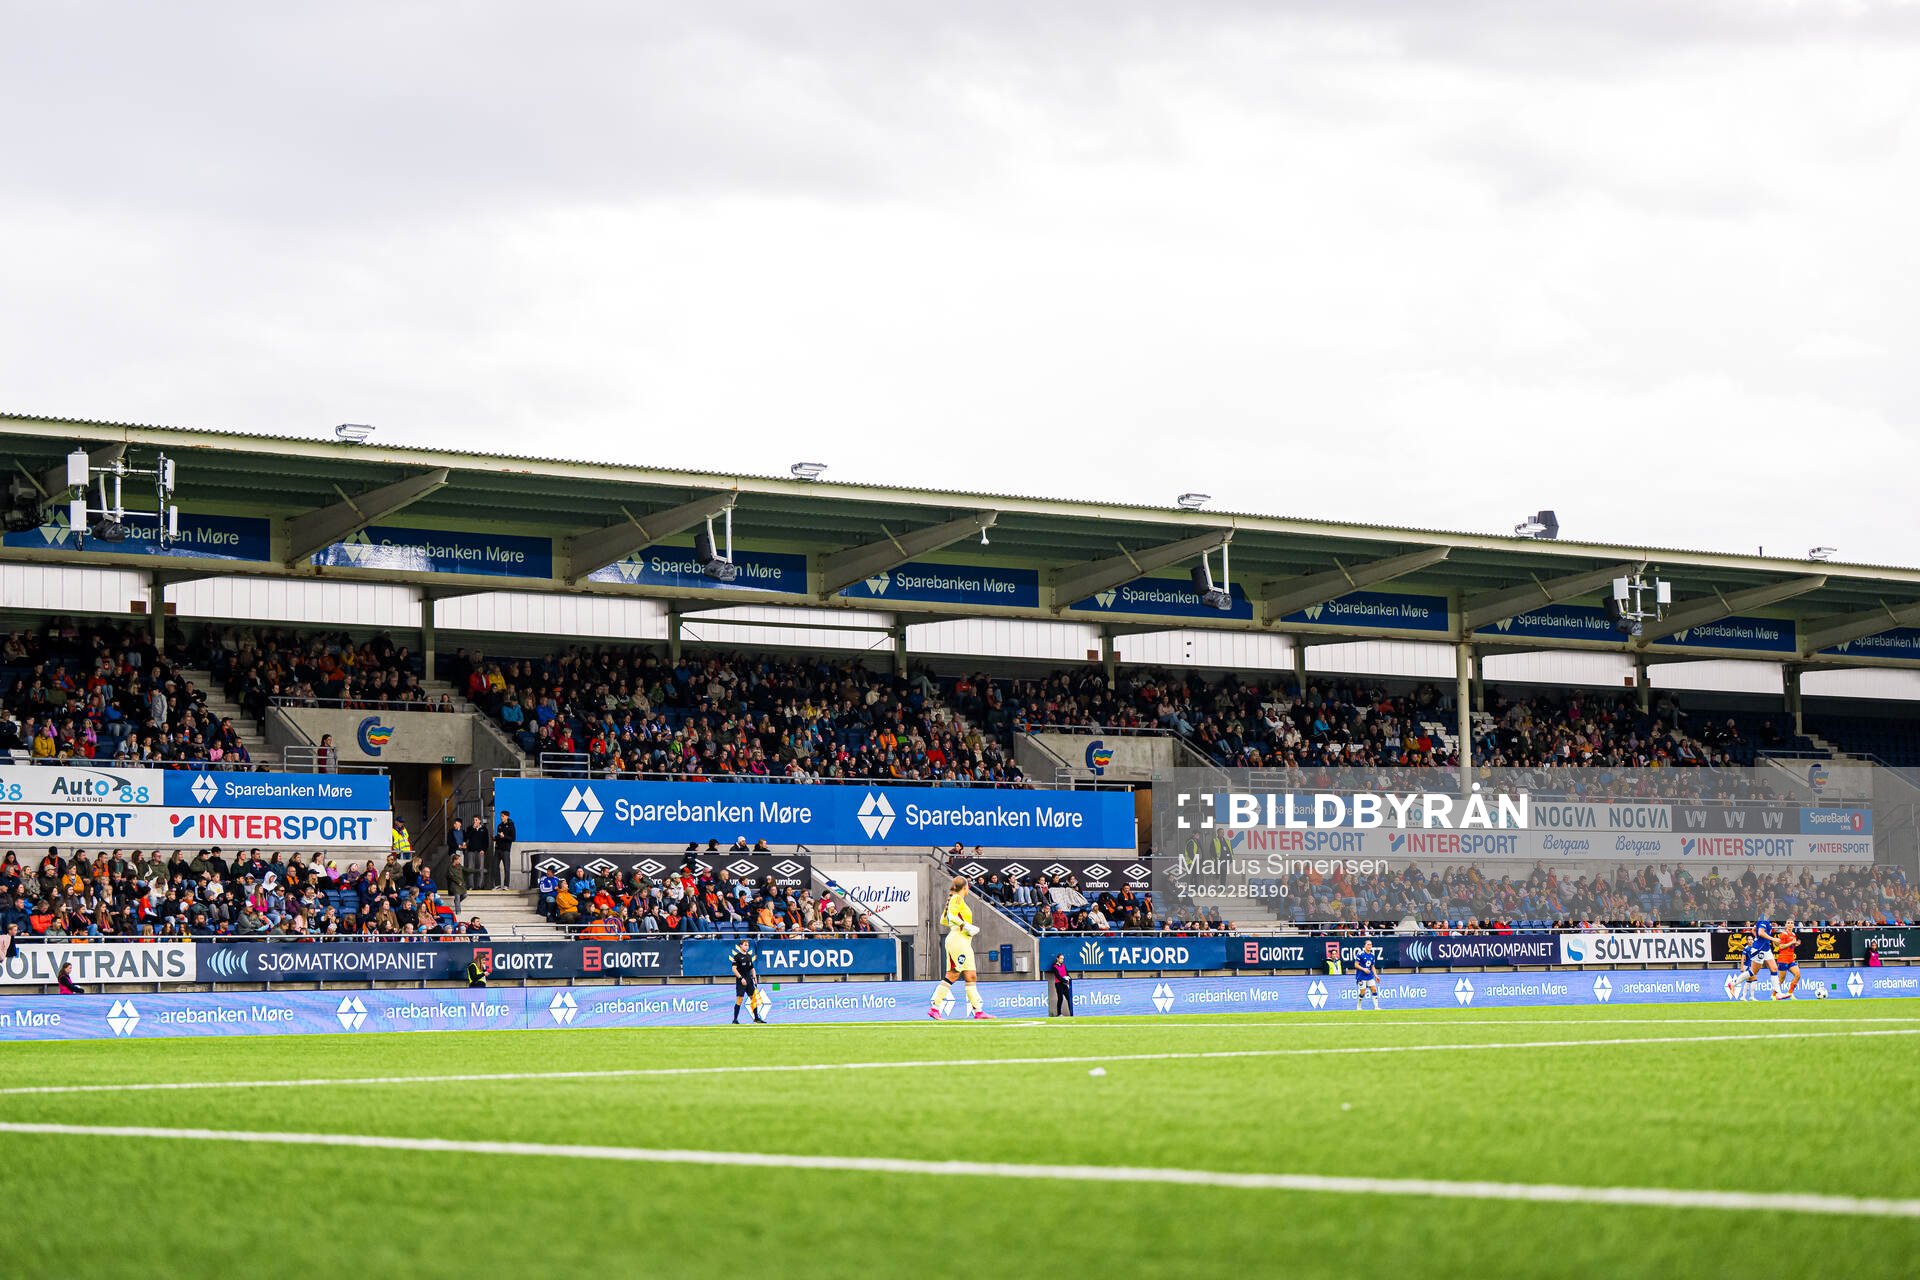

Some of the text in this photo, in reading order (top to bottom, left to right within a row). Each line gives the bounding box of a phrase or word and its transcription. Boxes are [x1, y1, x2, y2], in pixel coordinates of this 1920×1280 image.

[196, 527, 239, 545] Møre
[486, 546, 525, 563] Møre
[746, 563, 782, 579] Møre
[896, 572, 1016, 593] Sparebanken Møre
[1122, 586, 1200, 605] Sparebanken
[1328, 599, 1429, 618] Sparebanken Møre
[1517, 613, 1611, 630] Sparebanken Møre
[1693, 625, 1779, 640] Sparebanken Møre
[225, 782, 353, 799] Sparebanken Møre
[615, 798, 812, 826] Sparebanken Møre
[905, 804, 1083, 830] Sparebanken Møre
[1534, 806, 1597, 828] NOGVA
[1609, 807, 1669, 829] NOGVA
[1809, 812, 1851, 824] SpareBank
[199, 813, 373, 841] INTERSPORT
[1247, 830, 1365, 851] INTERSPORT
[1407, 833, 1518, 854] INTERSPORT
[1542, 834, 1590, 856] Bergans
[1615, 835, 1661, 857] Bergans
[1697, 837, 1795, 857] INTERSPORT
[1817, 842, 1870, 853] INTERSPORT
[775, 878, 801, 886] umbro
[1085, 880, 1110, 889] umbro
[762, 949, 854, 968] TAFJORD
[1108, 947, 1189, 965] TAFJORD
[1259, 947, 1304, 961] GIØRTZ
[1438, 942, 1553, 958] SJØMATKOMPANIET
[258, 952, 438, 971] SJØMATKOMPANIET
[494, 953, 554, 970] GIØRTZ
[603, 951, 660, 968] GIØRTZ
[1250, 987, 1279, 1002] Møre
[1400, 985, 1427, 999] Møre
[1541, 982, 1568, 995] Møre
[1675, 980, 1700, 993] Møre
[672, 997, 709, 1013] Møre
[862, 995, 896, 1010] Møre
[1090, 991, 1121, 1006] Møre
[251, 1005, 294, 1022] Møre
[470, 1002, 509, 1017] Møre
[15, 1010, 61, 1028] Møre
